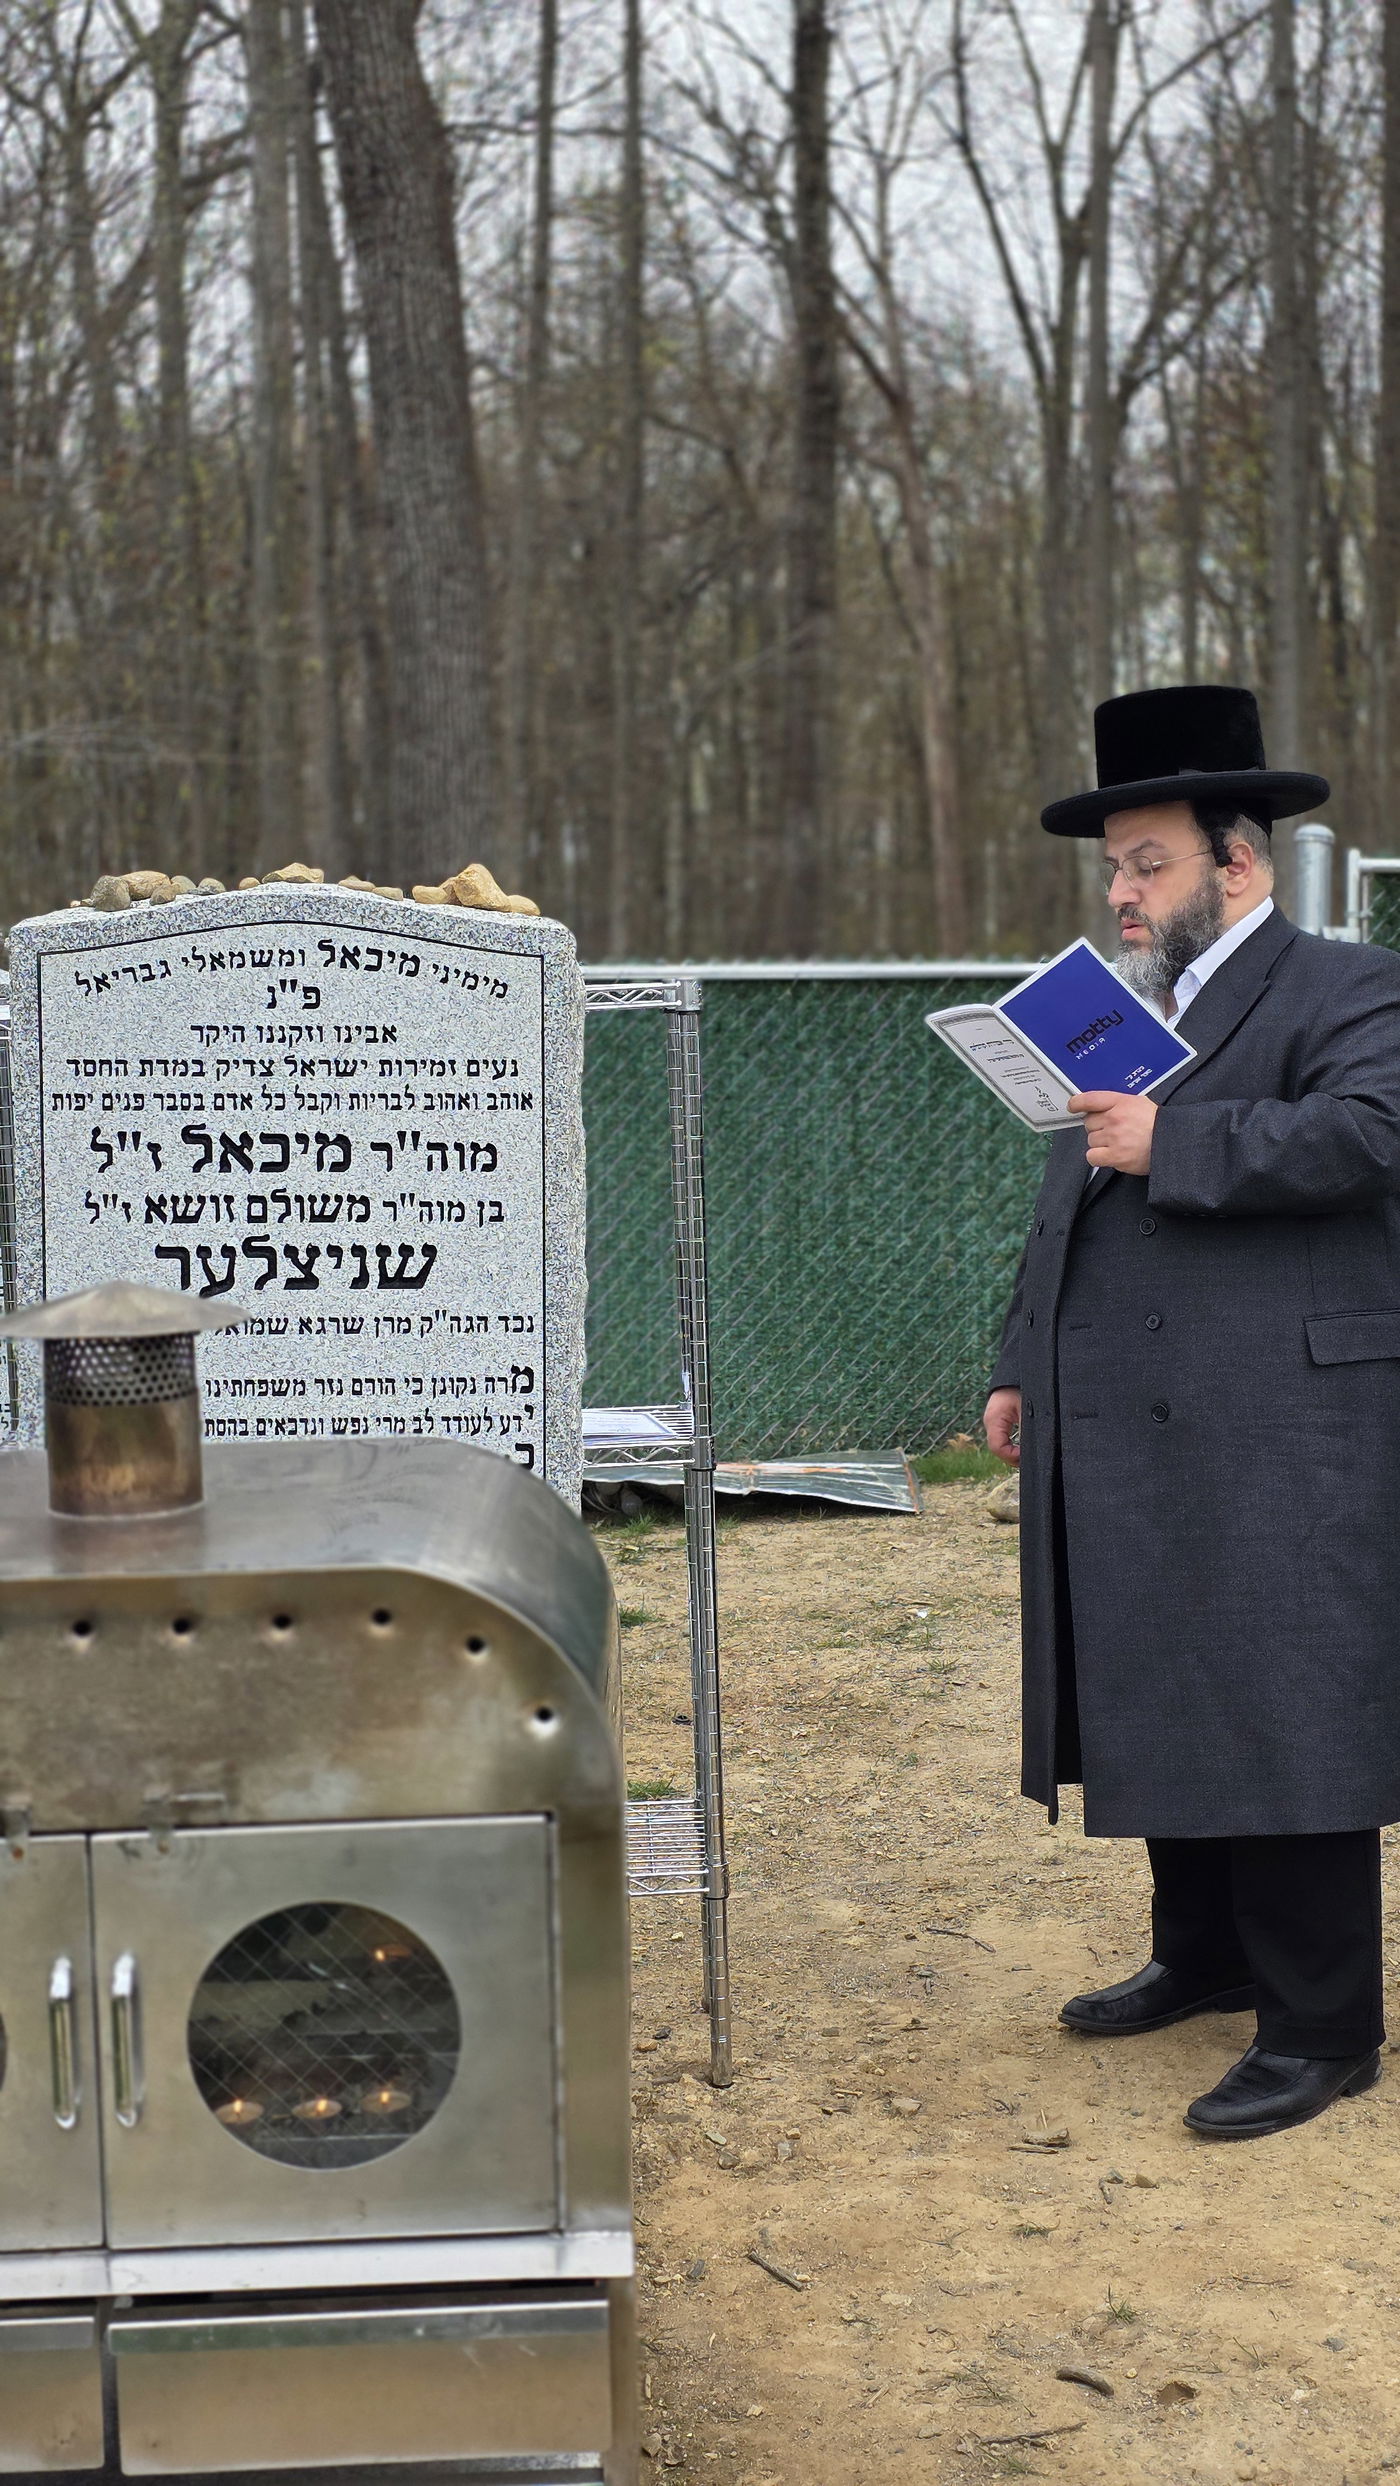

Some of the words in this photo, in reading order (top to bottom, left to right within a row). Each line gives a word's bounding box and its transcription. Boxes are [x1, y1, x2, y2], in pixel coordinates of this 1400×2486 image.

[181, 945, 306, 972] ומשמאלי
[317, 939, 421, 977] מיכאל
[75, 959, 172, 997] גבריאל
[432, 963, 508, 999] מימיני
[267, 979, 321, 1010] פ"נ
[190, 1025, 246, 1048] היקר
[256, 1025, 323, 1048] וזקננו
[333, 1025, 398, 1043] אבינו
[1066, 1008, 1125, 1054] motty
[66, 1059, 128, 1077] החסד
[140, 1059, 206, 1077] במדת
[216, 1059, 275, 1081] צדיק
[284, 1055, 368, 1077] ישראל
[379, 1059, 456, 1077] זמירות
[467, 1059, 519, 1081] נעים
[52, 1092, 93, 1111] יפות
[102, 1092, 145, 1111] פנים
[153, 1092, 205, 1111] בסבר
[213, 1092, 253, 1111] אדם
[261, 1084, 286, 1111] כל
[294, 1084, 340, 1115] וקבל
[349, 1084, 415, 1111] לבריות
[424, 1092, 478, 1111] ואהוב
[487, 1092, 534, 1111] אוהב
[90, 1126, 162, 1173] ז"ל
[180, 1123, 352, 1174] מיכאל
[370, 1130, 498, 1173] מוה"ר
[84, 1190, 131, 1224] ז"ל
[144, 1194, 235, 1224] זושא
[246, 1188, 371, 1224] משולם
[382, 1193, 465, 1223] מוה"ר
[477, 1200, 505, 1227] בן
[154, 1234, 438, 1299] שניצלער
[214, 1317, 289, 1336] שמוא
[298, 1317, 364, 1335] שרגא
[373, 1316, 411, 1338] מרן
[420, 1309, 488, 1338] הגה"ק
[498, 1315, 534, 1333] נכד
[205, 1378, 306, 1397] משפחתינו
[314, 1378, 344, 1396] נזר
[351, 1377, 396, 1396] הורם
[404, 1377, 423, 1395] כי
[431, 1377, 477, 1399] נקונן
[485, 1365, 534, 1394] מרה
[256, 1417, 324, 1436] ונדכאים
[332, 1417, 368, 1435] נפש
[376, 1416, 405, 1434] מרי
[412, 1408, 434, 1434] לב
[441, 1408, 493, 1436] לעודד
[500, 1404, 534, 1436] ידע
